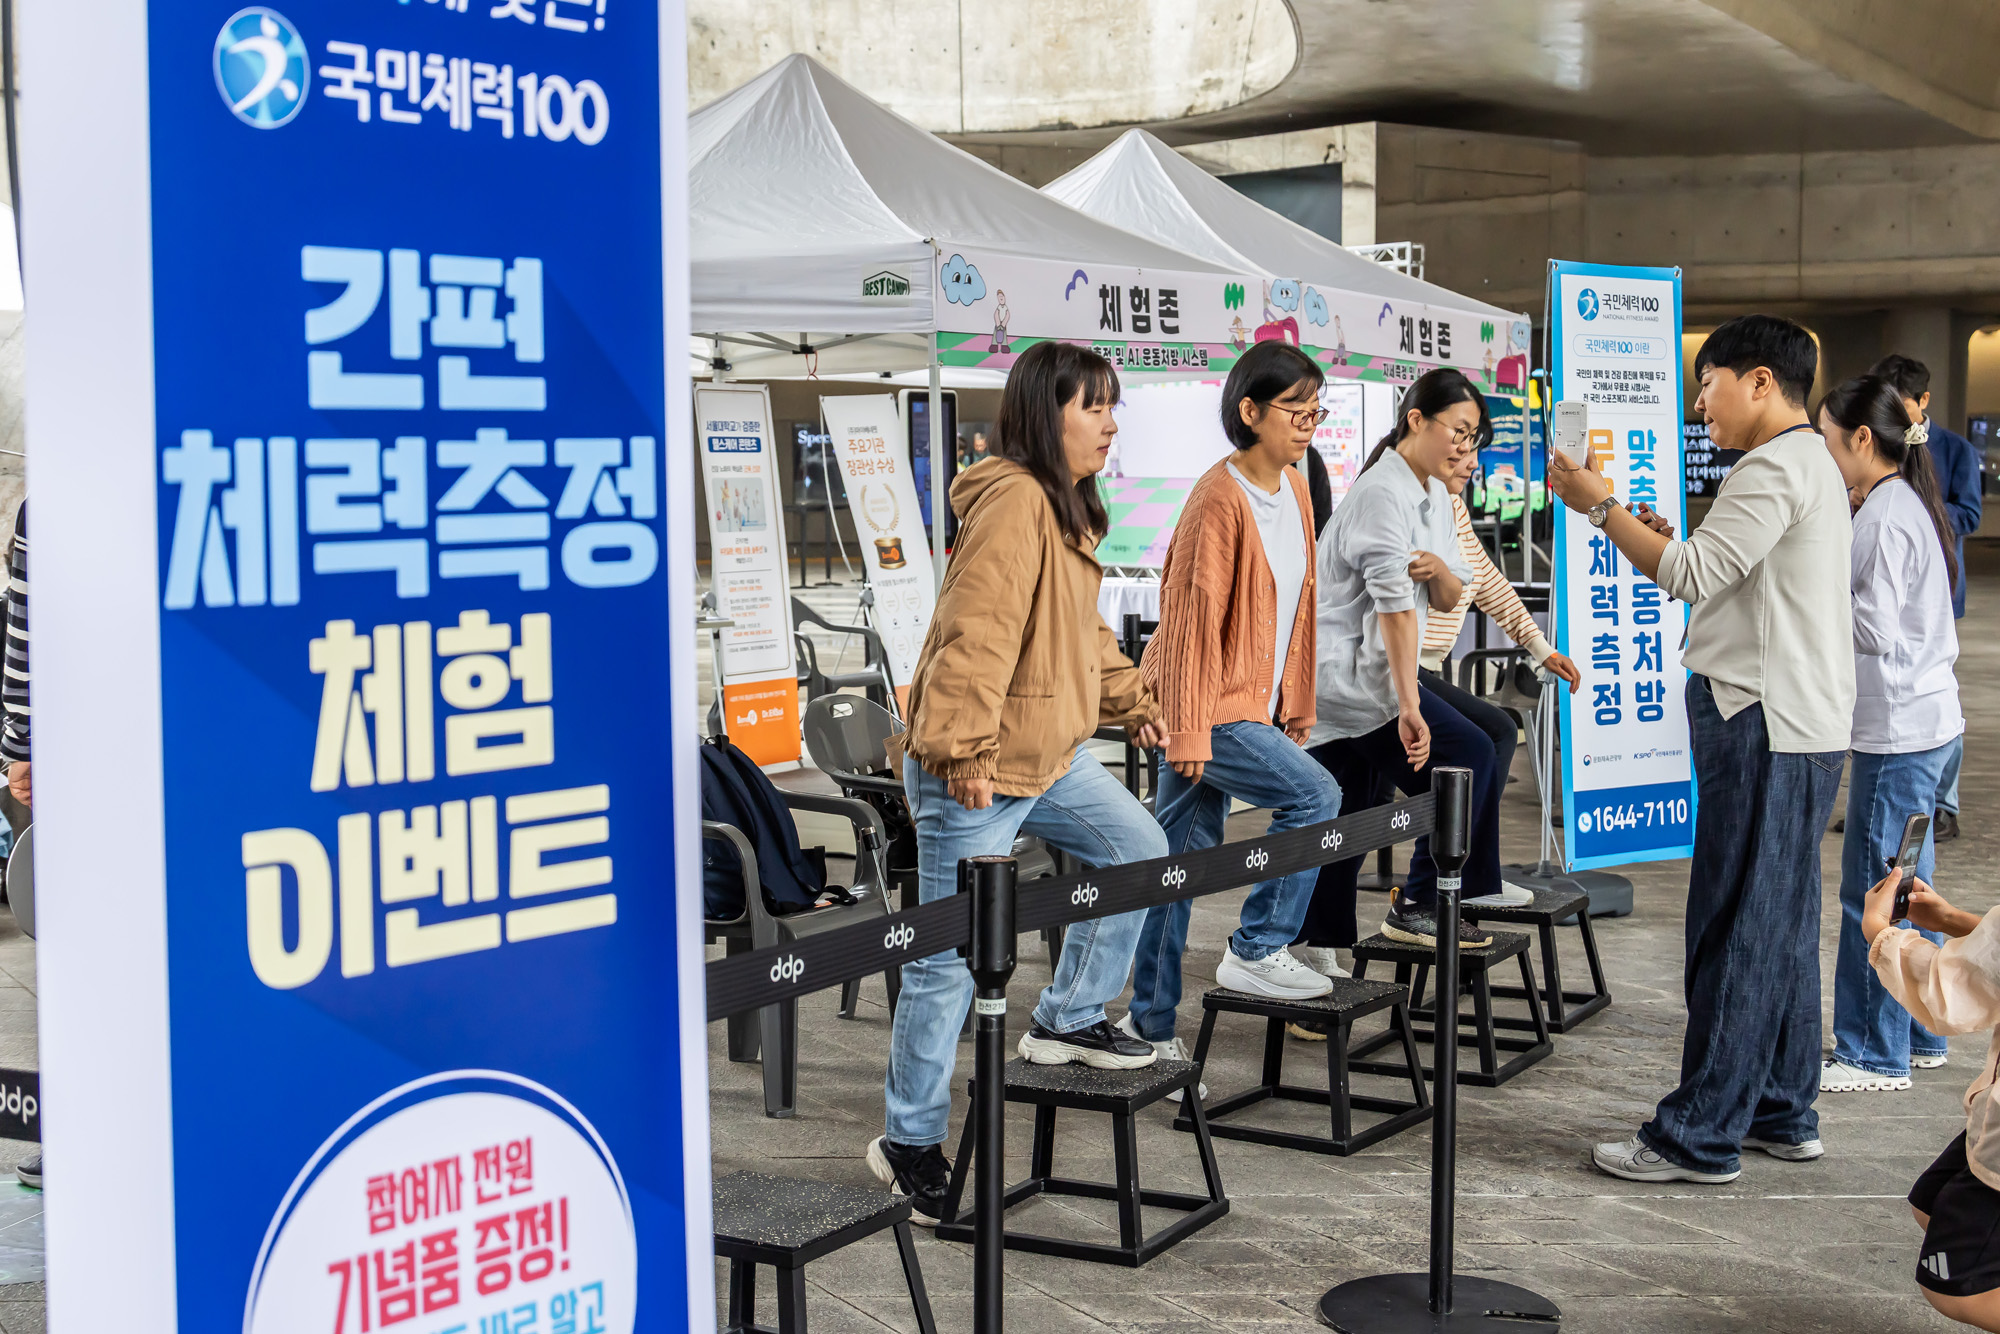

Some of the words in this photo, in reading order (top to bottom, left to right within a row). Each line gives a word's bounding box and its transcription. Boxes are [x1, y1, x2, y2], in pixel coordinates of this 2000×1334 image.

[319, 40, 610, 146] 국민체력100
[864, 277, 886, 296] BEST
[1098, 284, 1180, 335] 체험존
[1602, 293, 1660, 313] 국민체력100
[301, 245, 547, 411] 간편
[1602, 313, 1625, 321] NATIONAL
[1625, 314, 1644, 322] FITNESS
[1644, 315, 1660, 323] AWARD
[1399, 315, 1451, 360] 체험존
[1585, 338, 1633, 355] 국민체력100
[1634, 342, 1650, 355] 이란
[1115, 347, 1125, 366] 및
[1127, 348, 1139, 366] AI
[1142, 348, 1179, 367] 운동처방
[1181, 349, 1209, 367] 시스템
[1383, 363, 1407, 380] 자세측정
[1576, 368, 1592, 379] 국민의
[1611, 370, 1622, 380] 건강
[1655, 372, 1666, 381] 두고
[1592, 381, 1613, 392] 국가에서
[1613, 382, 1630, 392] 무료로
[1590, 393, 1601, 404] 국민
[1601, 394, 1628, 404] 스포츠복지
[797, 429, 833, 449] Spec
[847, 436, 886, 456] 주요기관
[846, 457, 875, 477] 장관상
[876, 456, 895, 474] 수상
[1686, 452, 1713, 465] DDP
[162, 427, 659, 611] 체력측정
[1588, 535, 1622, 726] 체력측정
[1632, 562, 1666, 723] 동처방
[309, 609, 555, 793] 체험
[1633, 752, 1652, 760] KSPO
[1391, 810, 1410, 831] ddp
[1593, 798, 1687, 832] 1644-7110
[1321, 829, 1343, 851] ddp
[1245, 848, 1269, 870] ddp
[241, 783, 618, 991] 이벤트
[1161, 865, 1187, 889] ddp
[1071, 882, 1099, 908] ddp
[884, 922, 915, 950] ddp
[770, 954, 804, 983] ddp
[366, 1155, 463, 1236] 참여자
[472, 1136, 534, 1206] 전원
[328, 1227, 460, 1334] 기념품
[474, 1196, 571, 1297] 증정!
